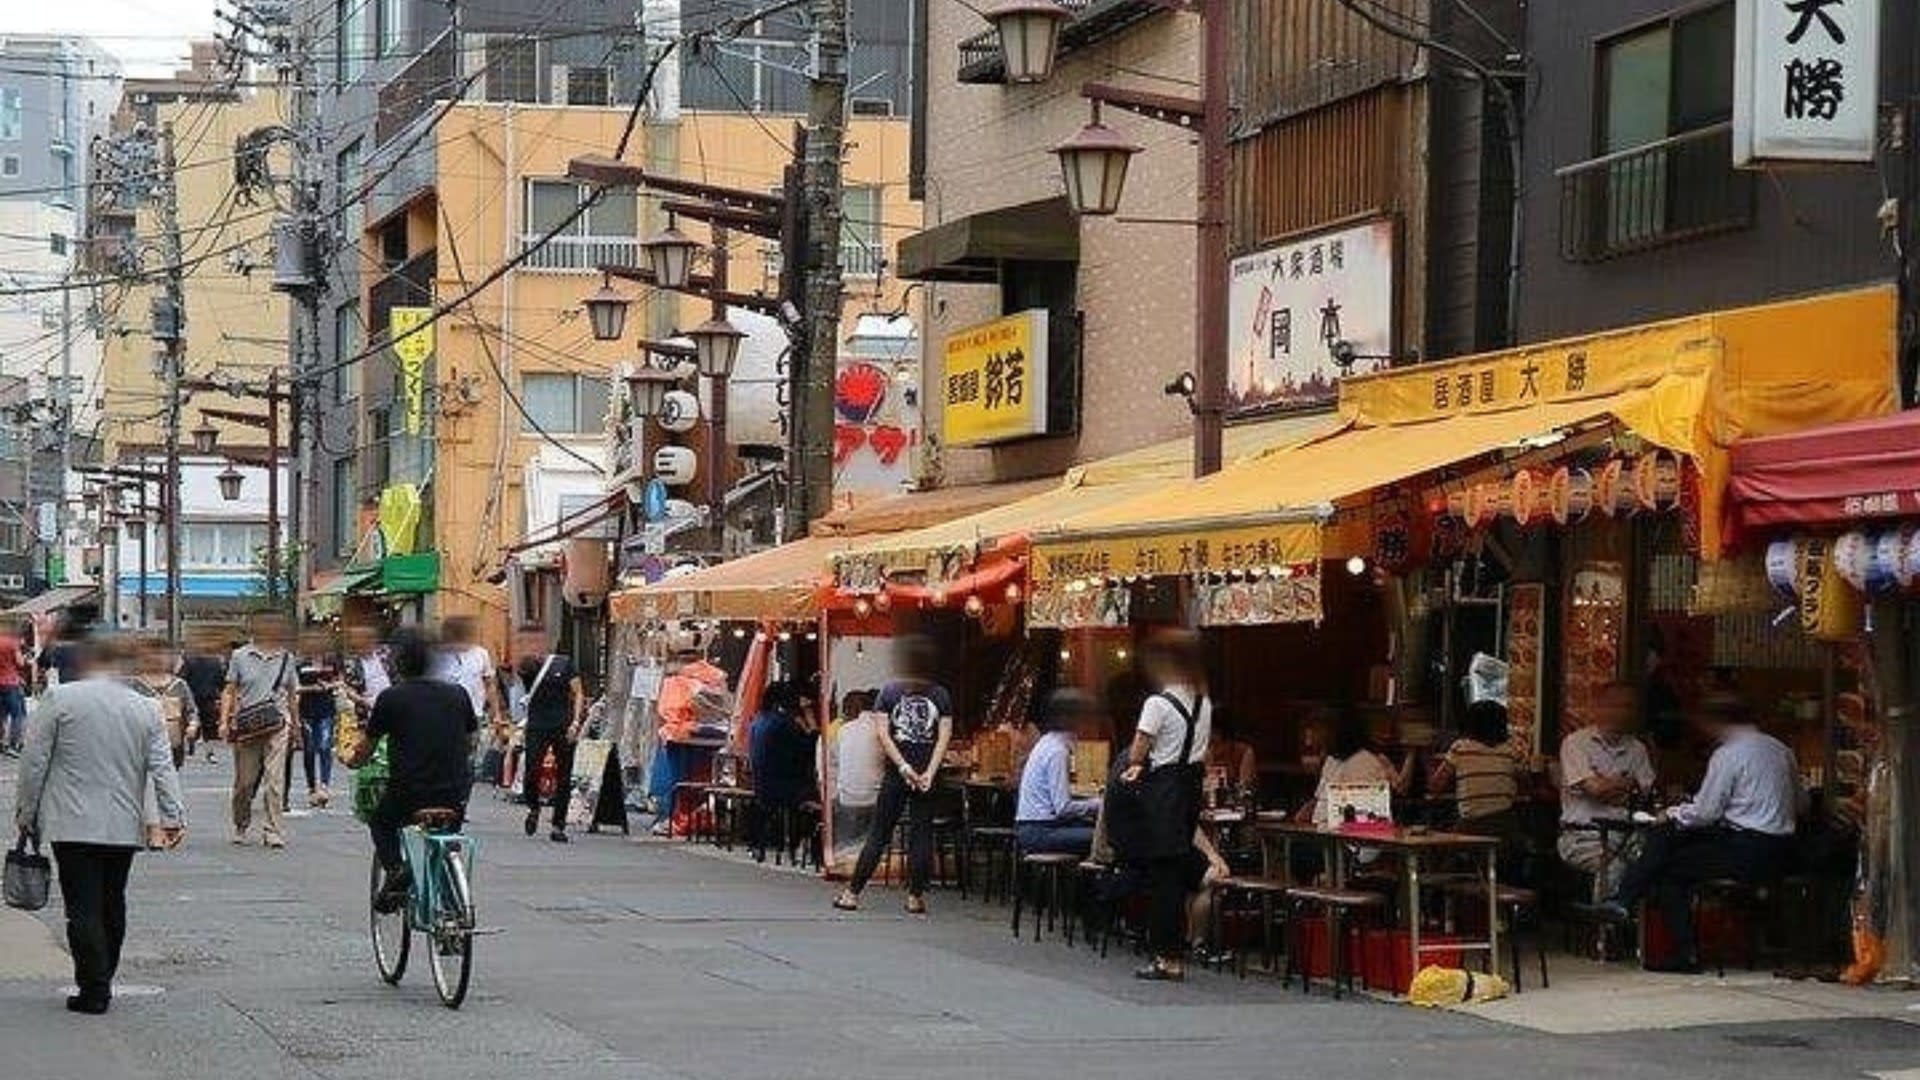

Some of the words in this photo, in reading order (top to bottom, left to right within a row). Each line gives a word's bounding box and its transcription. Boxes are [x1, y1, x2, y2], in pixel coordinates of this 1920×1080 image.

[1784, 0, 1846, 120] 大勝
[1271, 240, 1345, 281] 大衆酒場
